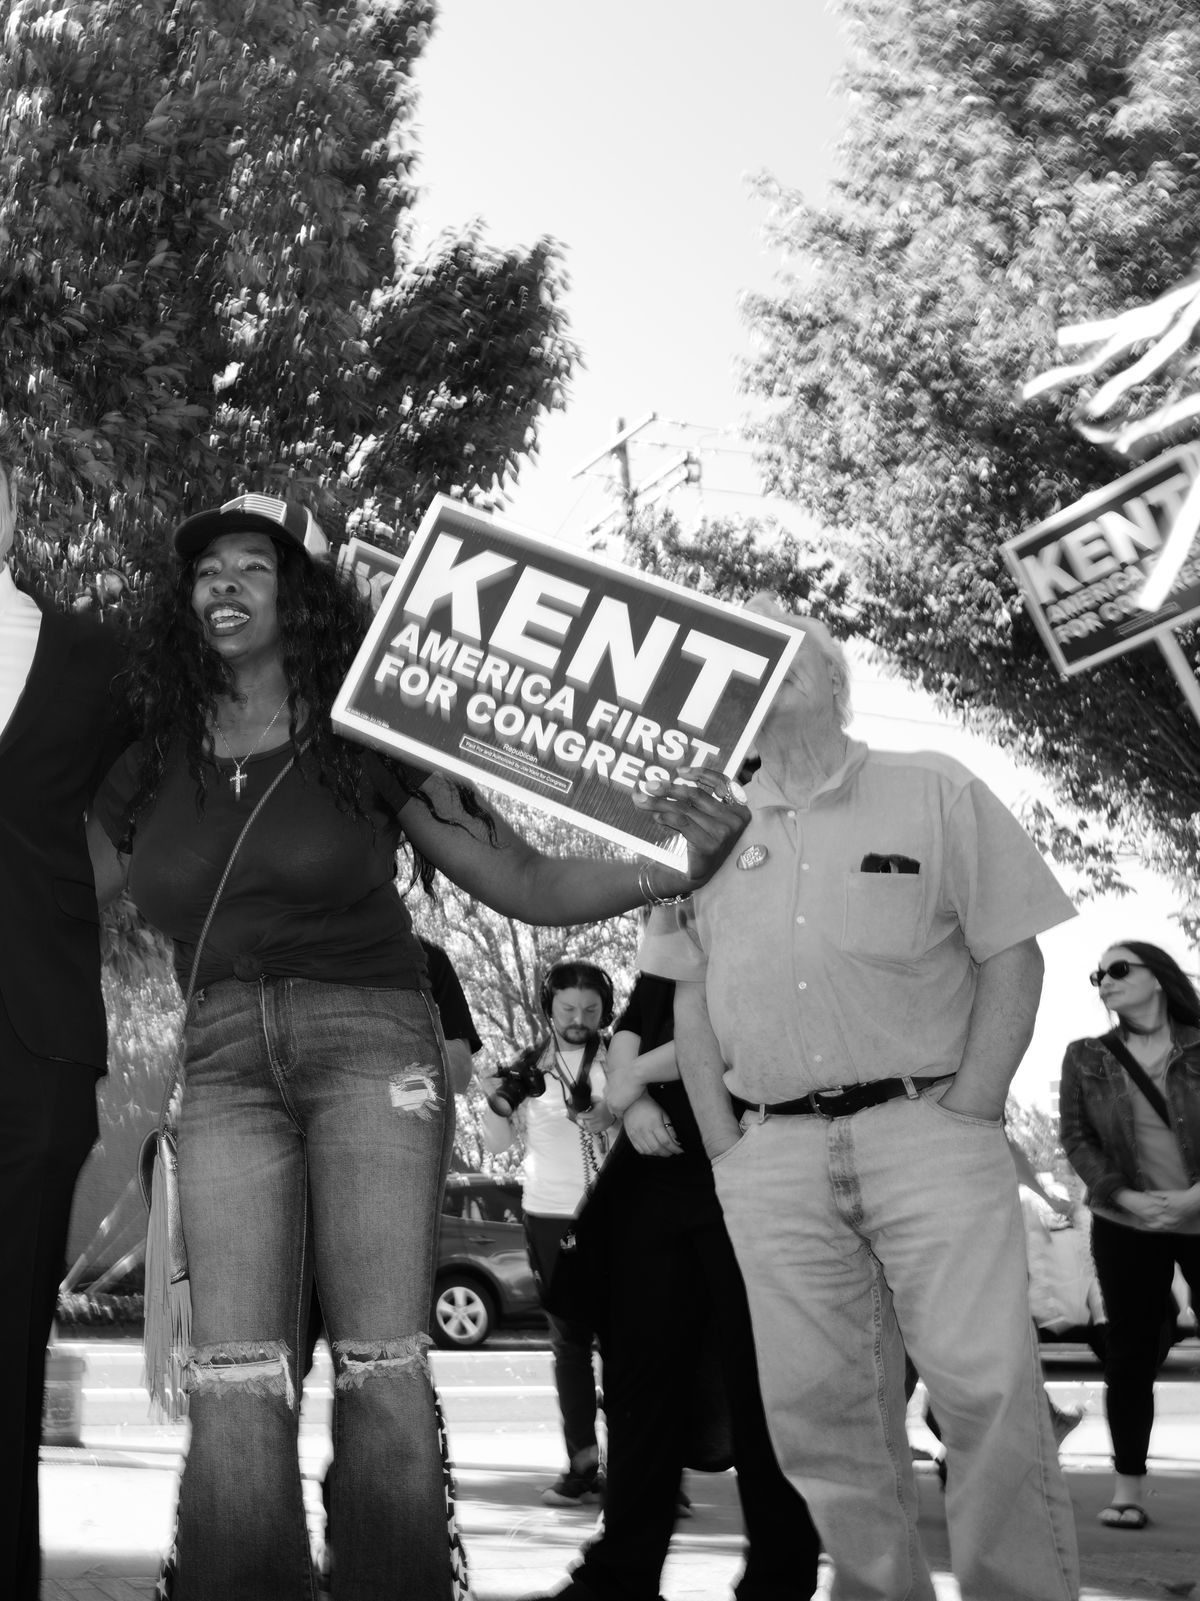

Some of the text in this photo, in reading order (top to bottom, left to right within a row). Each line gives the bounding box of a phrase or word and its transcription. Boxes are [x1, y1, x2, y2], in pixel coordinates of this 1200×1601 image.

[1018, 472, 1191, 605] KENT
[374, 651, 458, 711] FOR
[390, 621, 720, 767] AMERICA FIRST
[403, 532, 769, 730] KENT
[502, 743, 538, 763] Republican
